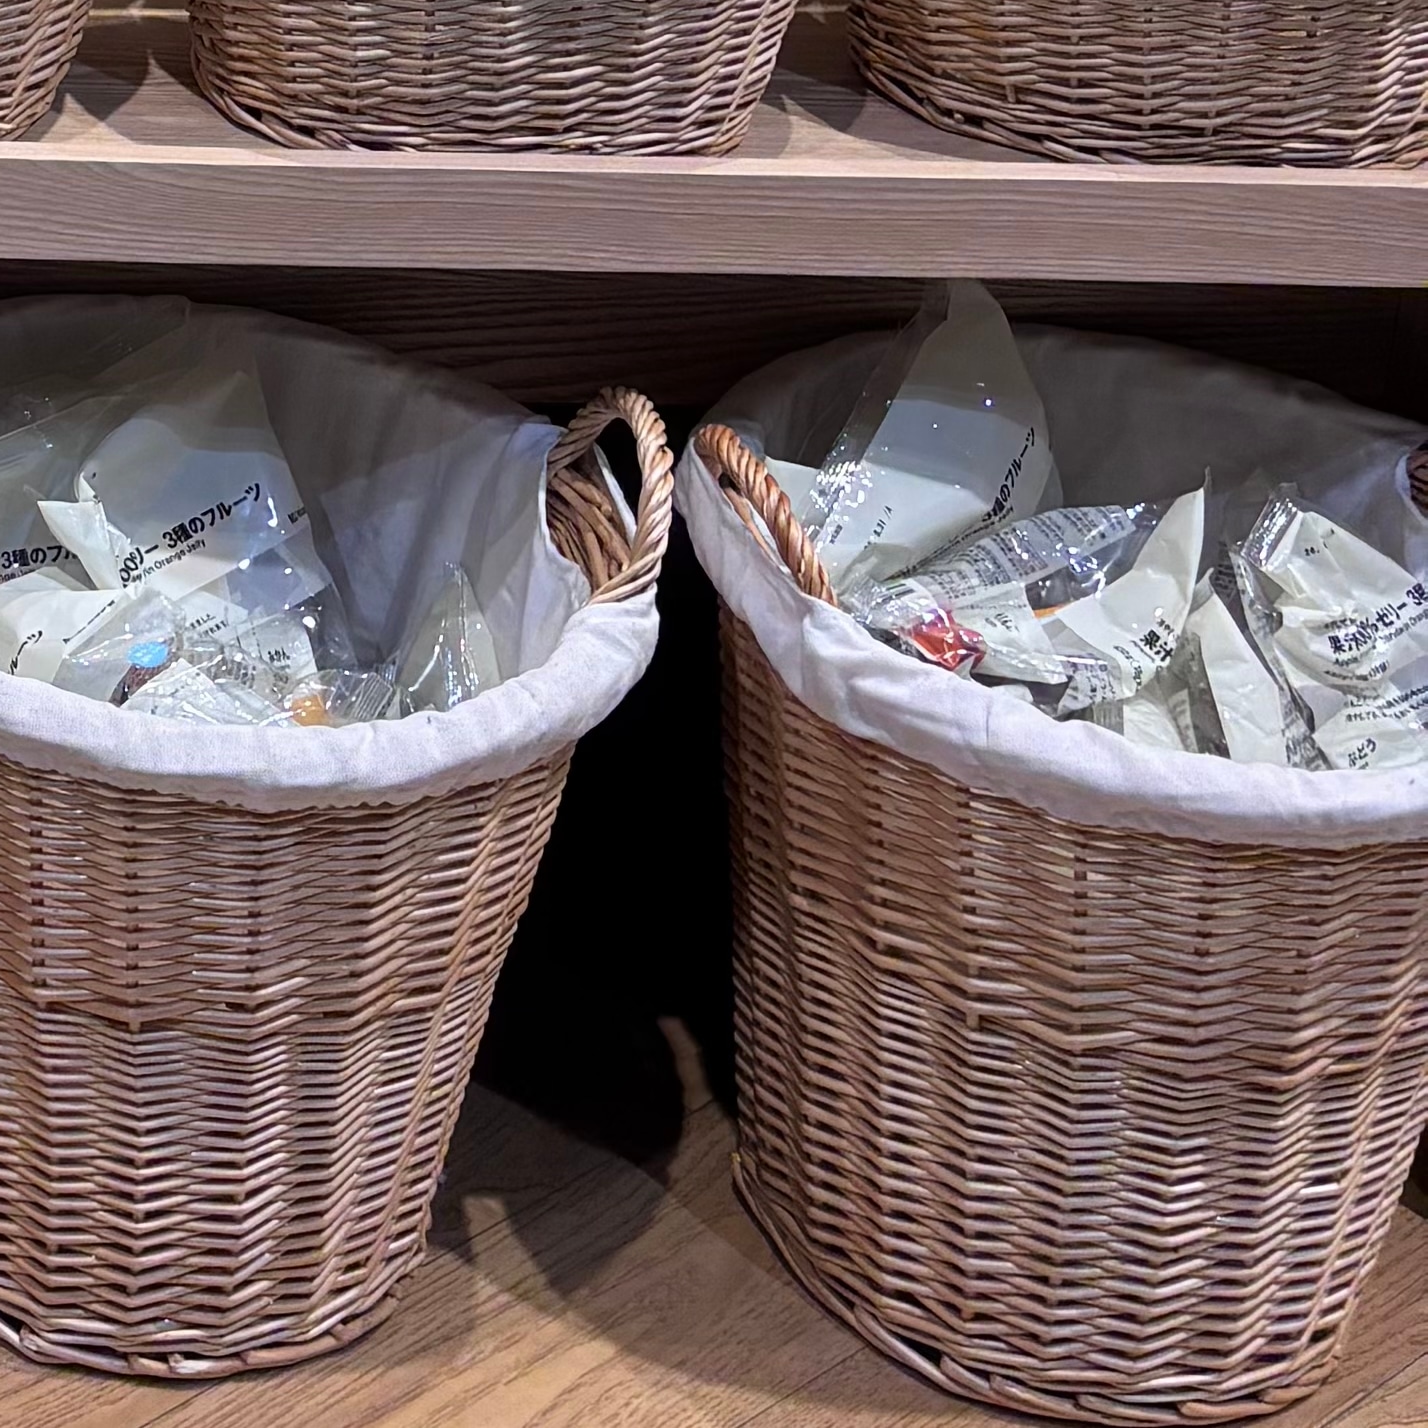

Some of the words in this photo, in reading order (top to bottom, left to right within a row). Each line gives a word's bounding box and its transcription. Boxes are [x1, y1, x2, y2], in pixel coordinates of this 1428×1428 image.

[162, 482, 261, 548] 3種のフルーツ
